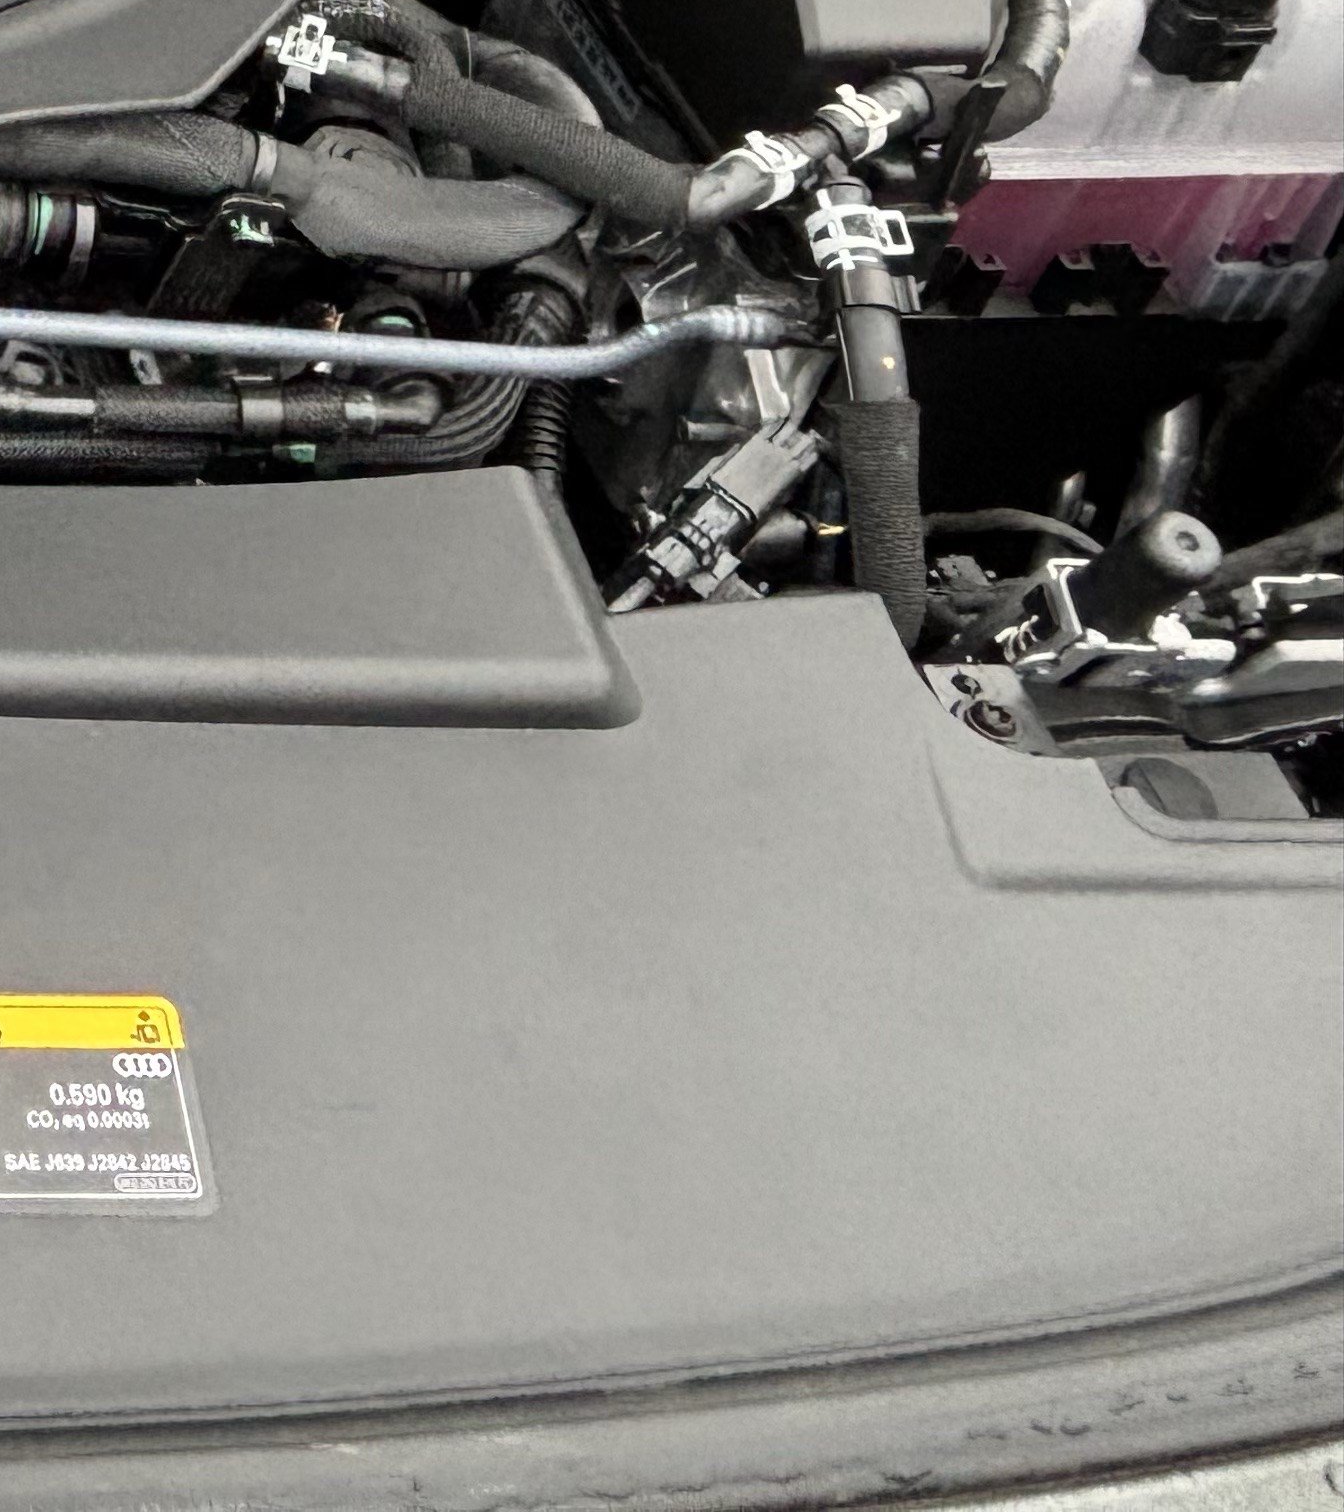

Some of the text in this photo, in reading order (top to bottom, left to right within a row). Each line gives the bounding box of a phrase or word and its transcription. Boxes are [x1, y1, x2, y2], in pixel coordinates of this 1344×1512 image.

[49, 1083, 112, 1106] 0.590
[115, 1083, 145, 1110] kg
[4, 1154, 41, 1171] SAE
